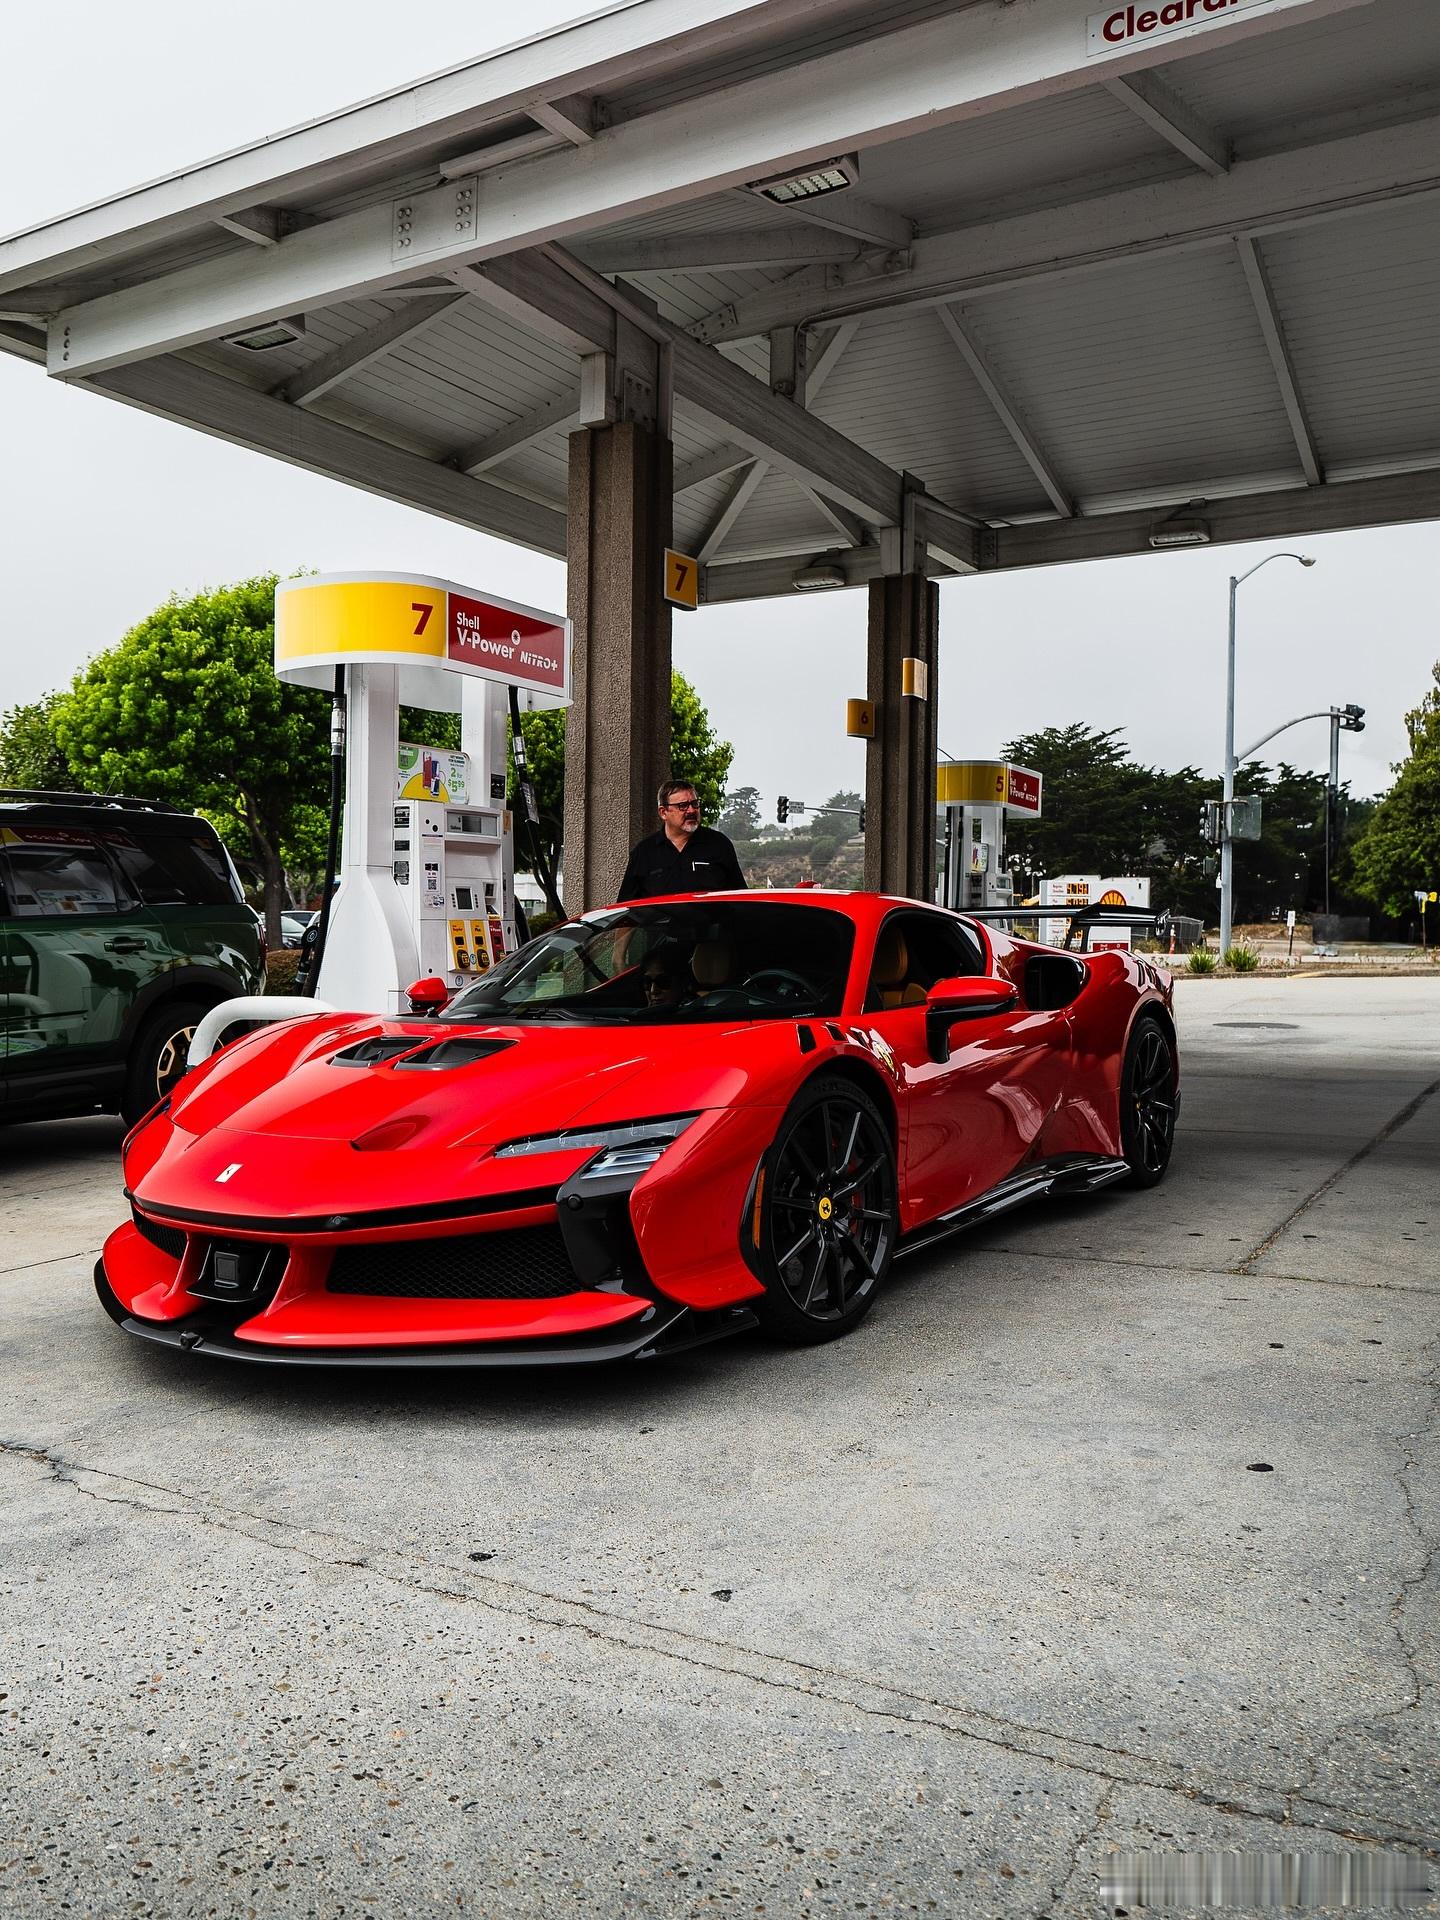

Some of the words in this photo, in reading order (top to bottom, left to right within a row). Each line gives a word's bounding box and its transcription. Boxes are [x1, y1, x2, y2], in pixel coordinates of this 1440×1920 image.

[675, 563, 688, 592] 7
[411, 603, 434, 636] 7
[456, 612, 480, 630] Shell
[457, 626, 515, 660] V-Power
[861, 711, 868, 724] 6
[450, 767, 456, 777] 2
[996, 775, 1004, 792] 5
